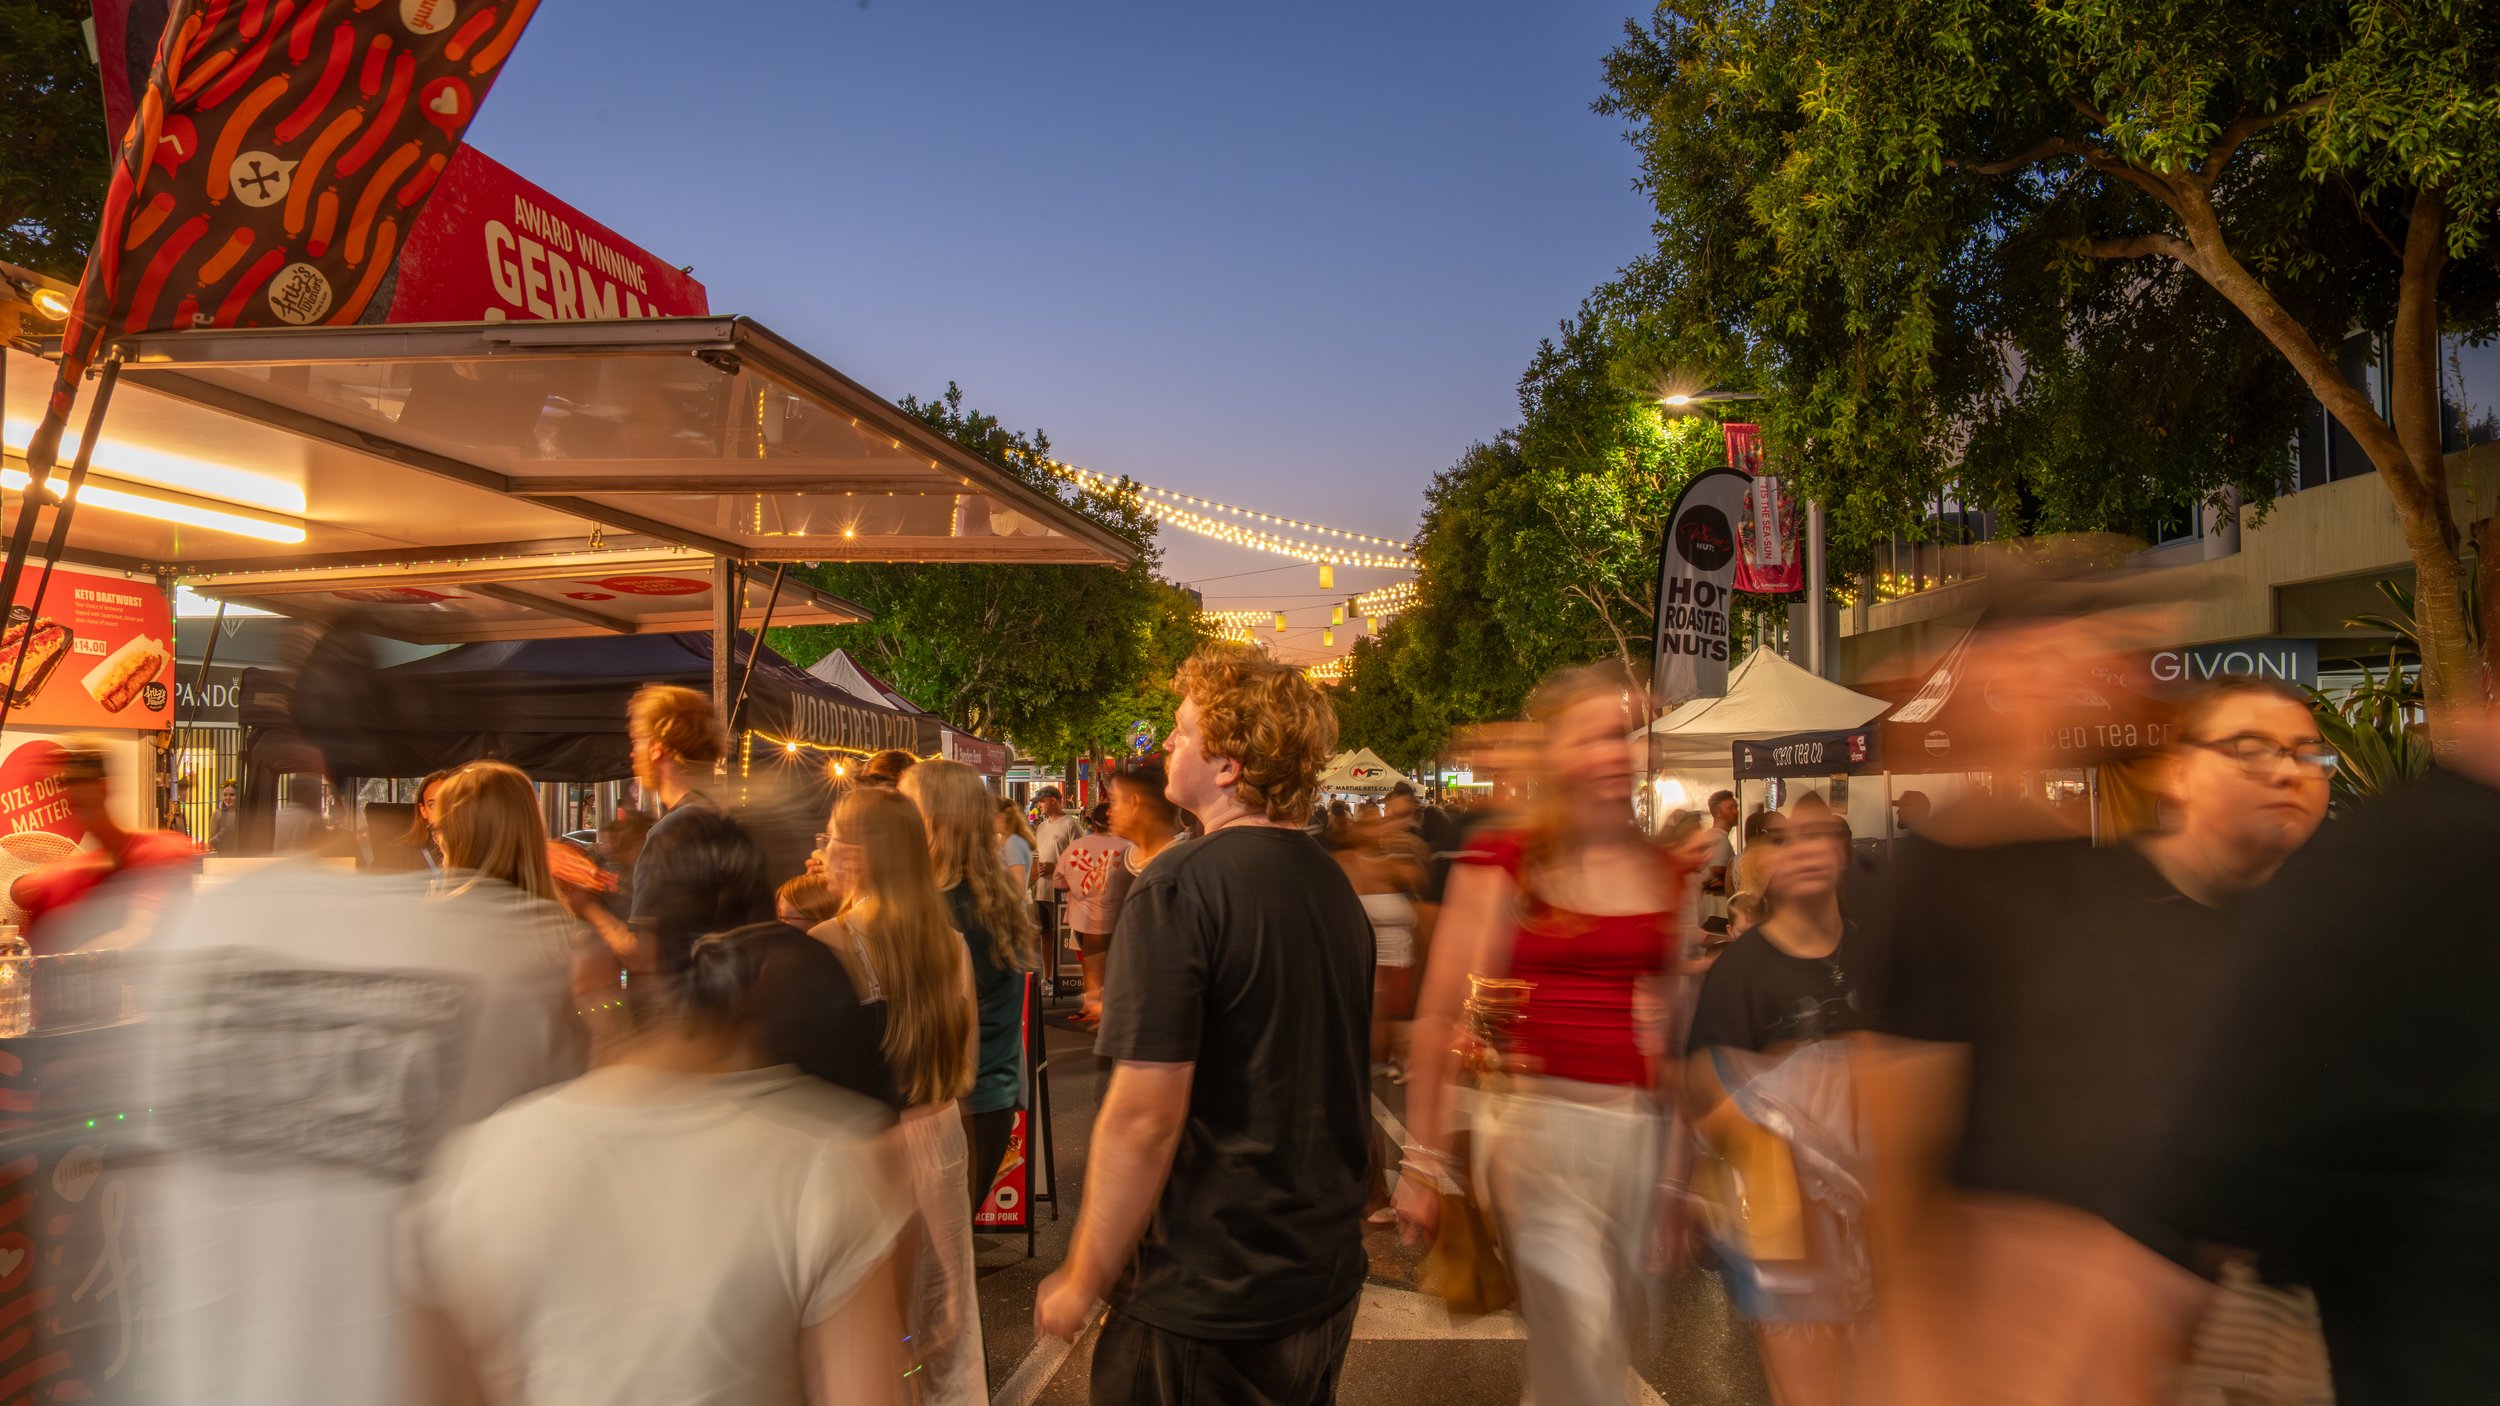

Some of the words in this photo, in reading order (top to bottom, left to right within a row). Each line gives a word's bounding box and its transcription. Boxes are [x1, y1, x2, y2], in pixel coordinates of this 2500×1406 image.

[515, 193, 573, 253] AWARD
[575, 228, 648, 295] WINNING
[484, 219, 672, 320] GERM
[1761, 501, 1770, 519] THE
[1762, 521, 1772, 560] SEA-SUN
[75, 588, 95, 601] KETO
[96, 591, 143, 608] BRATWURST
[1668, 576, 1727, 611] HOT
[1664, 605, 1727, 638] ROASTED
[74, 640, 105, 653] $14.00
[1662, 632, 1728, 662] NUTS
[2150, 652, 2297, 682] GIVONI
[791, 691, 880, 752] WOODFIRED
[882, 713, 919, 754] PIZZA
[2043, 726, 2087, 750] CeD
[1353, 767, 1383, 778] MF
[0, 785, 34, 815] SIZE
[11, 798, 72, 833] MATTER
[997, 1212, 1018, 1222] PORK
